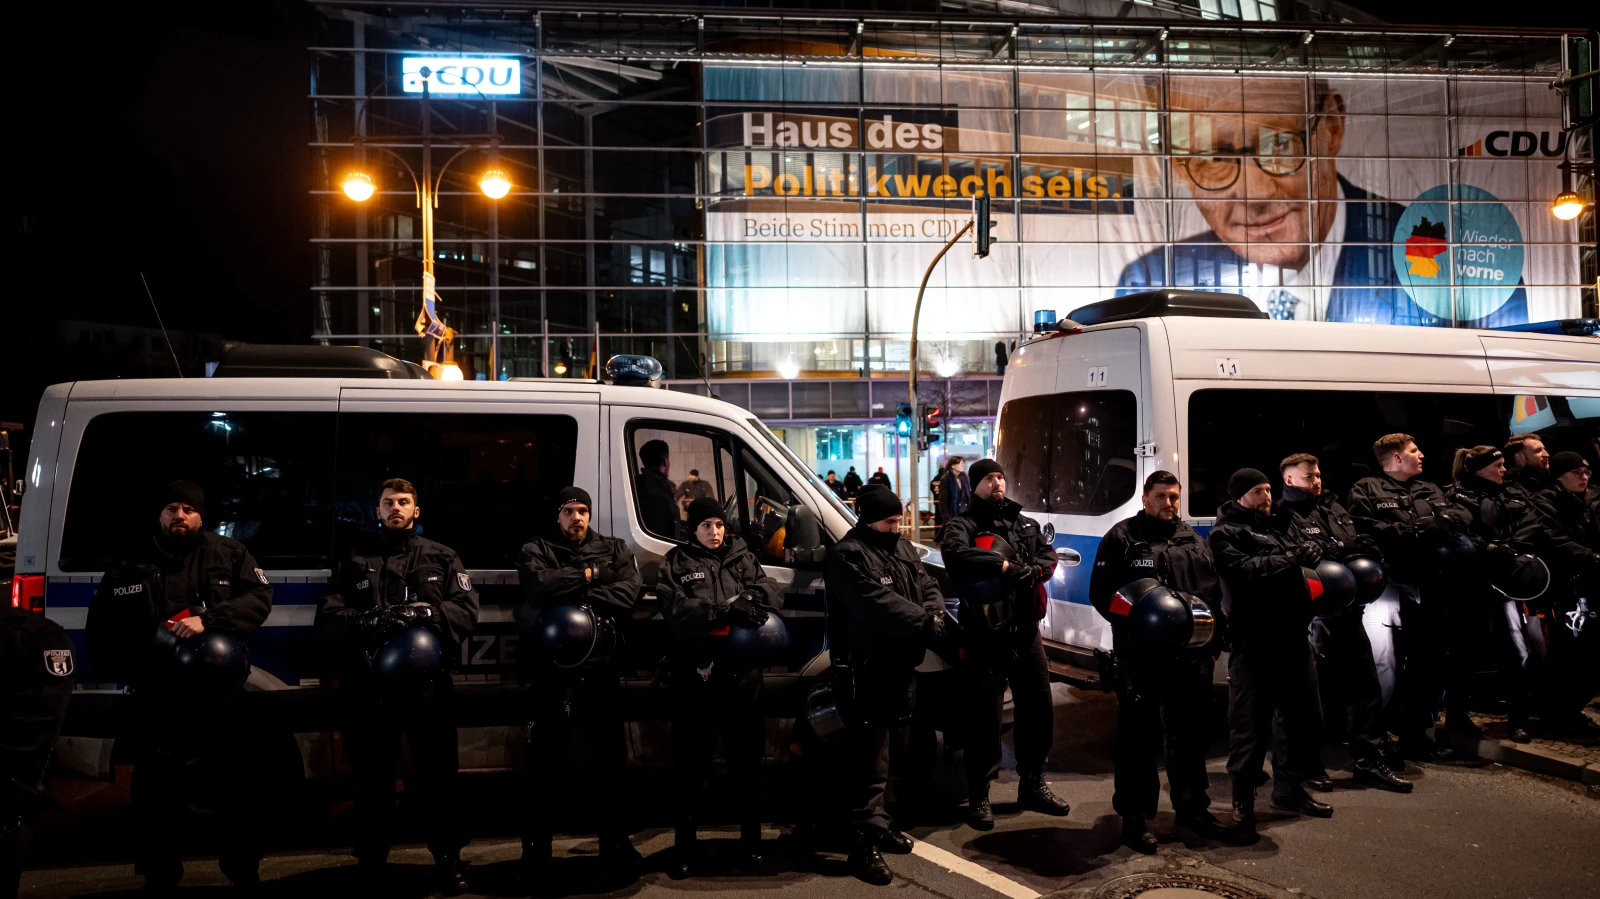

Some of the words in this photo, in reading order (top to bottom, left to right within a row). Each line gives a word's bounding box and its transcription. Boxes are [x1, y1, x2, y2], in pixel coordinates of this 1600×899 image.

[436, 65, 512, 86] CDU
[743, 112, 853, 148] Haus
[868, 115, 943, 149] des
[1485, 130, 1566, 157] CDU
[744, 218, 804, 237] Beide
[810, 218, 916, 238] Stimmen
[1460, 229, 1514, 250] Wieder
[1457, 248, 1495, 263] nach
[1456, 264, 1504, 281] vorne
[680, 572, 705, 584] POLIZEI
[113, 583, 143, 597] POLIZEI
